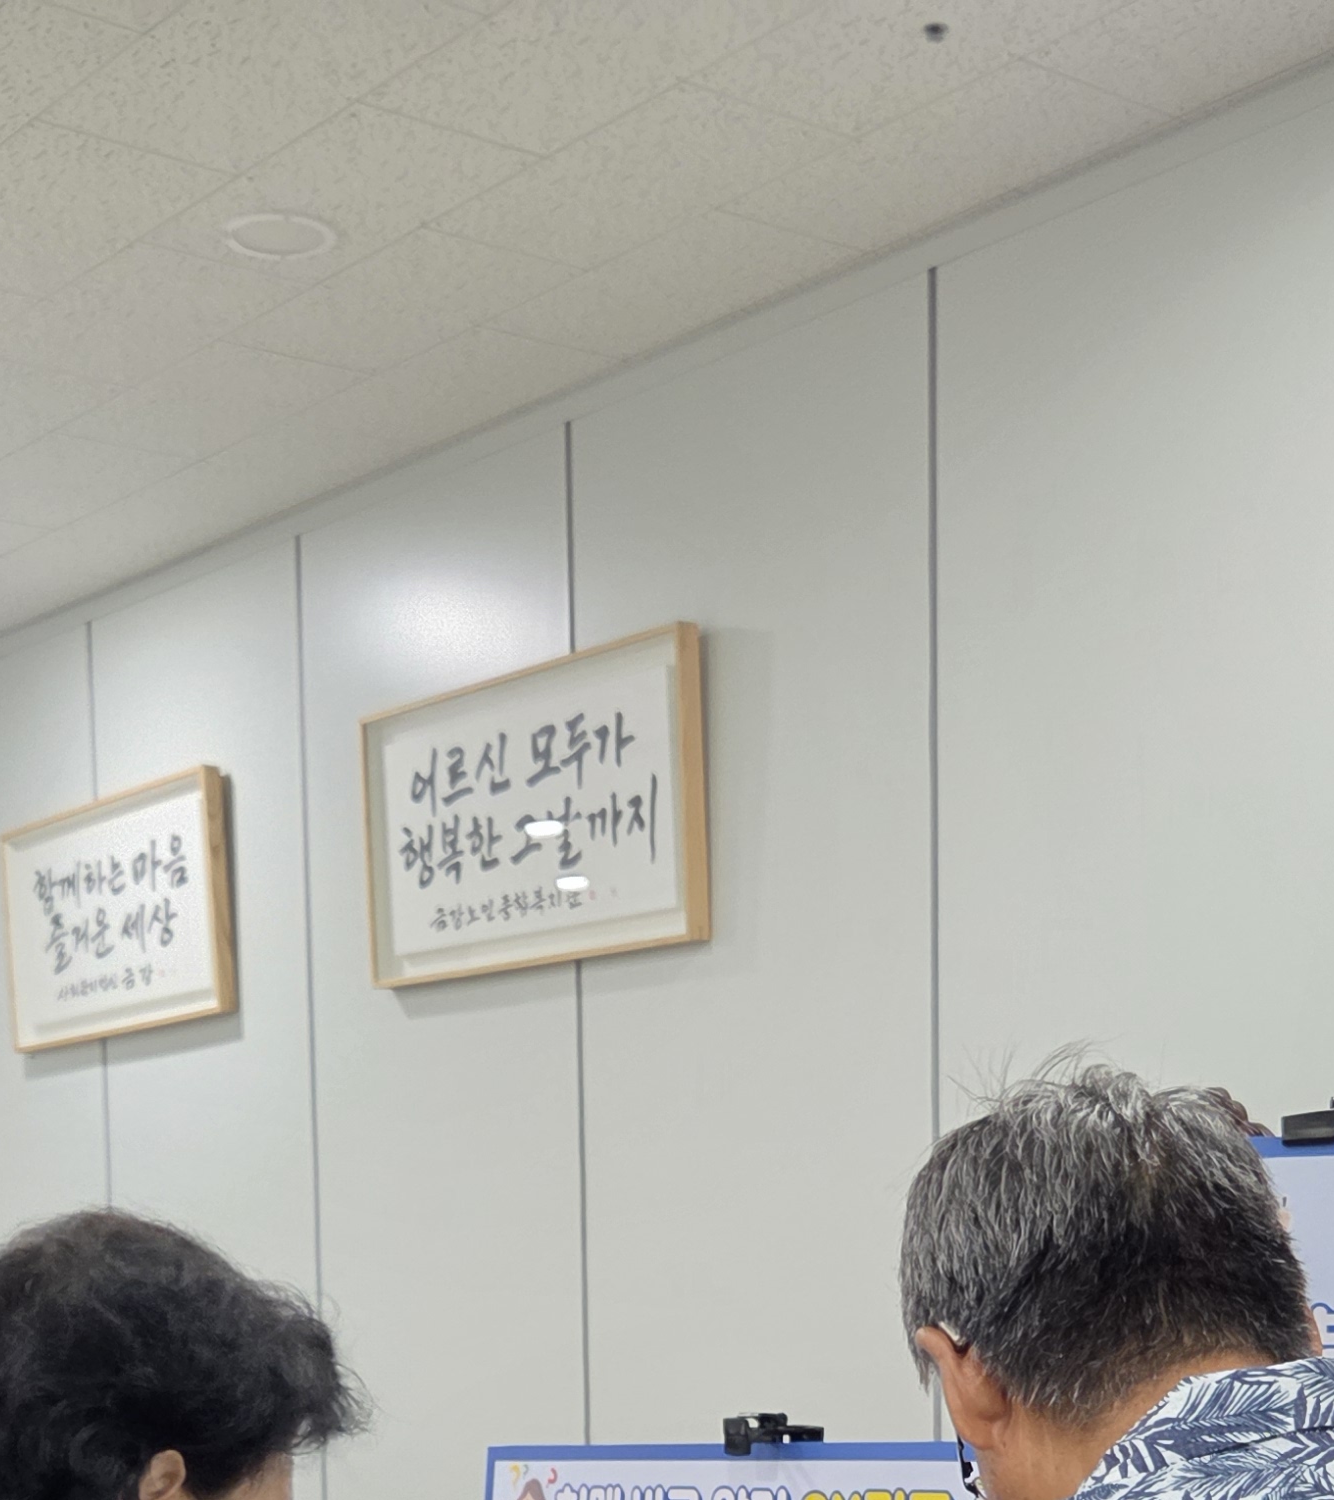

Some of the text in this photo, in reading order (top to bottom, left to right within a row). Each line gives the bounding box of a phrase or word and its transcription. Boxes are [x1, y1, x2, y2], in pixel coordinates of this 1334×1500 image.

[411, 711, 636, 817] 어르신 모두가
[400, 814, 503, 890] 행복한
[121, 898, 179, 953] 세상
